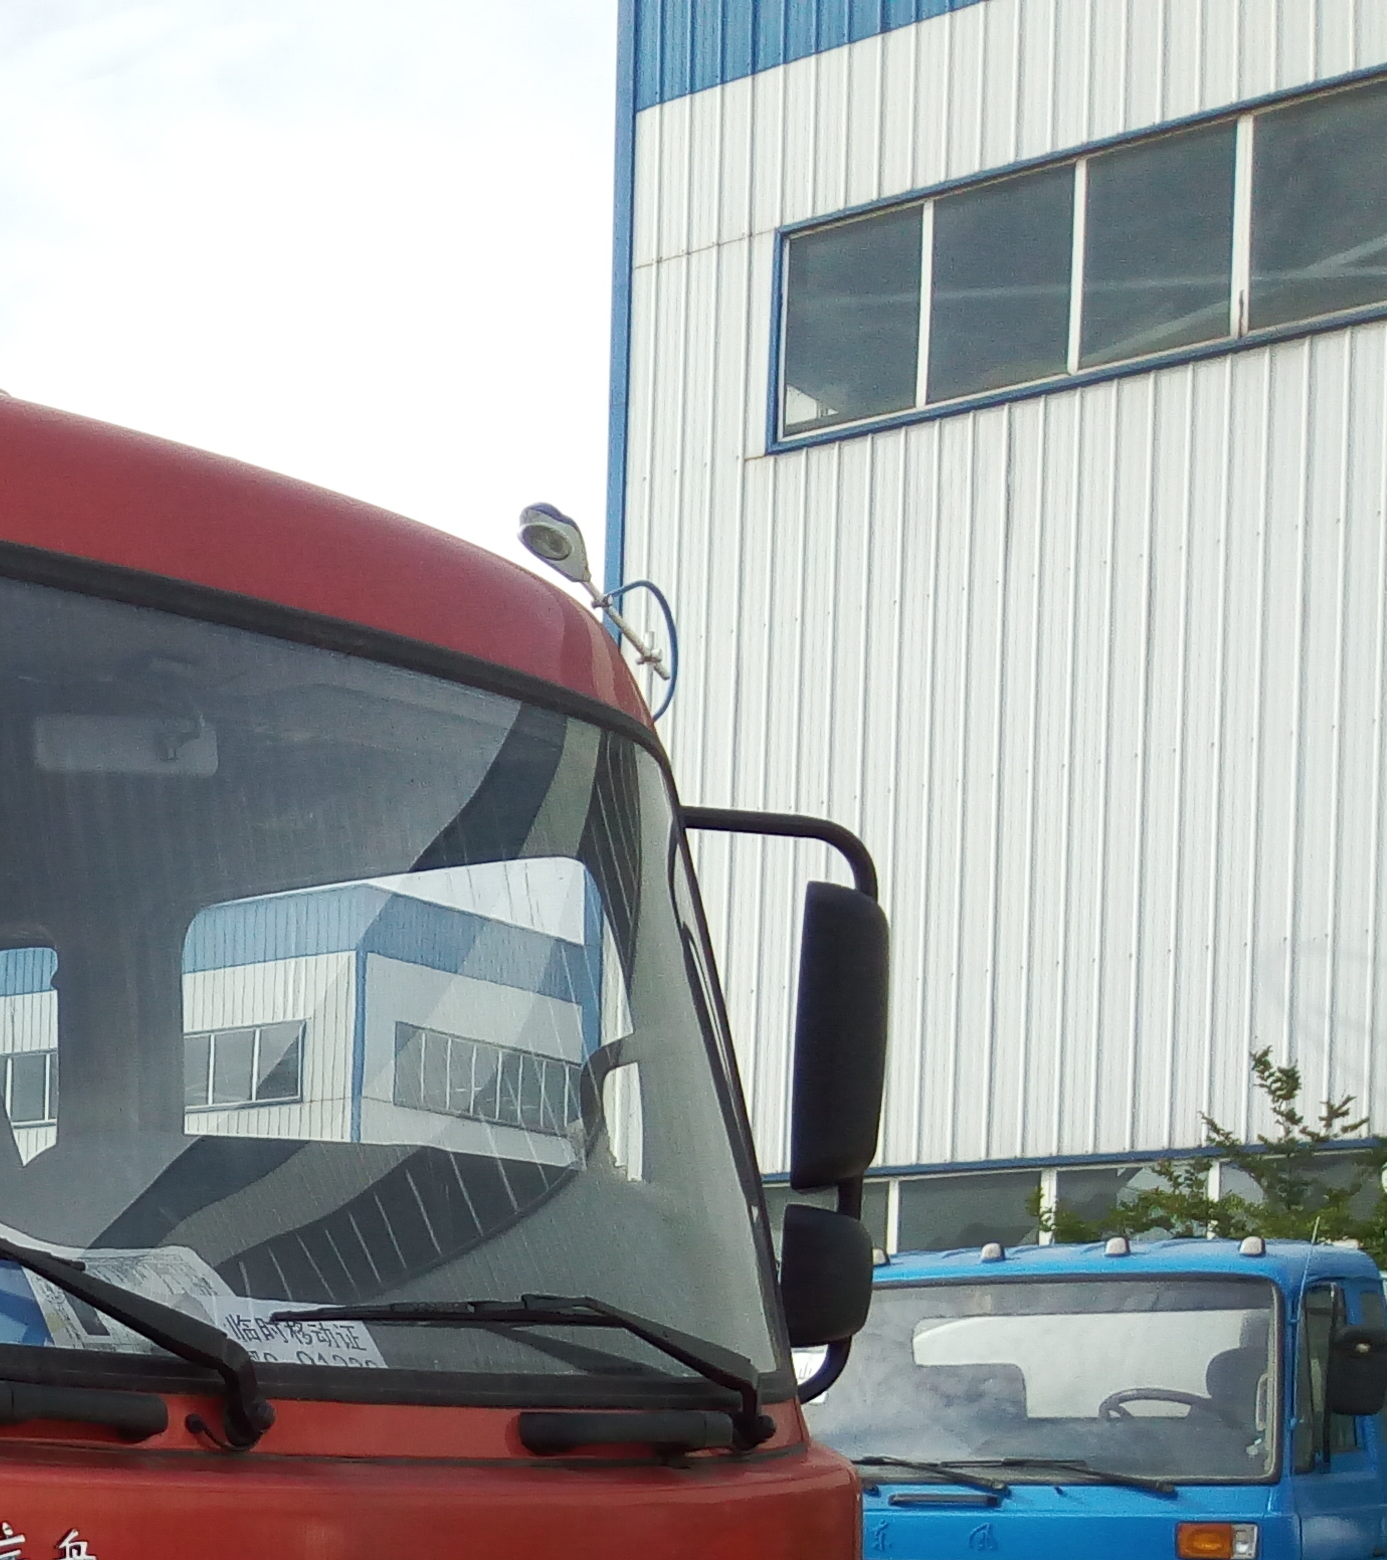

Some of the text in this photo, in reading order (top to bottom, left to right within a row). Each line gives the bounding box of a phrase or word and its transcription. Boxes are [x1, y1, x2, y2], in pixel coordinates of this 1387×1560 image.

[227, 1314, 367, 1351] 临时移动证
